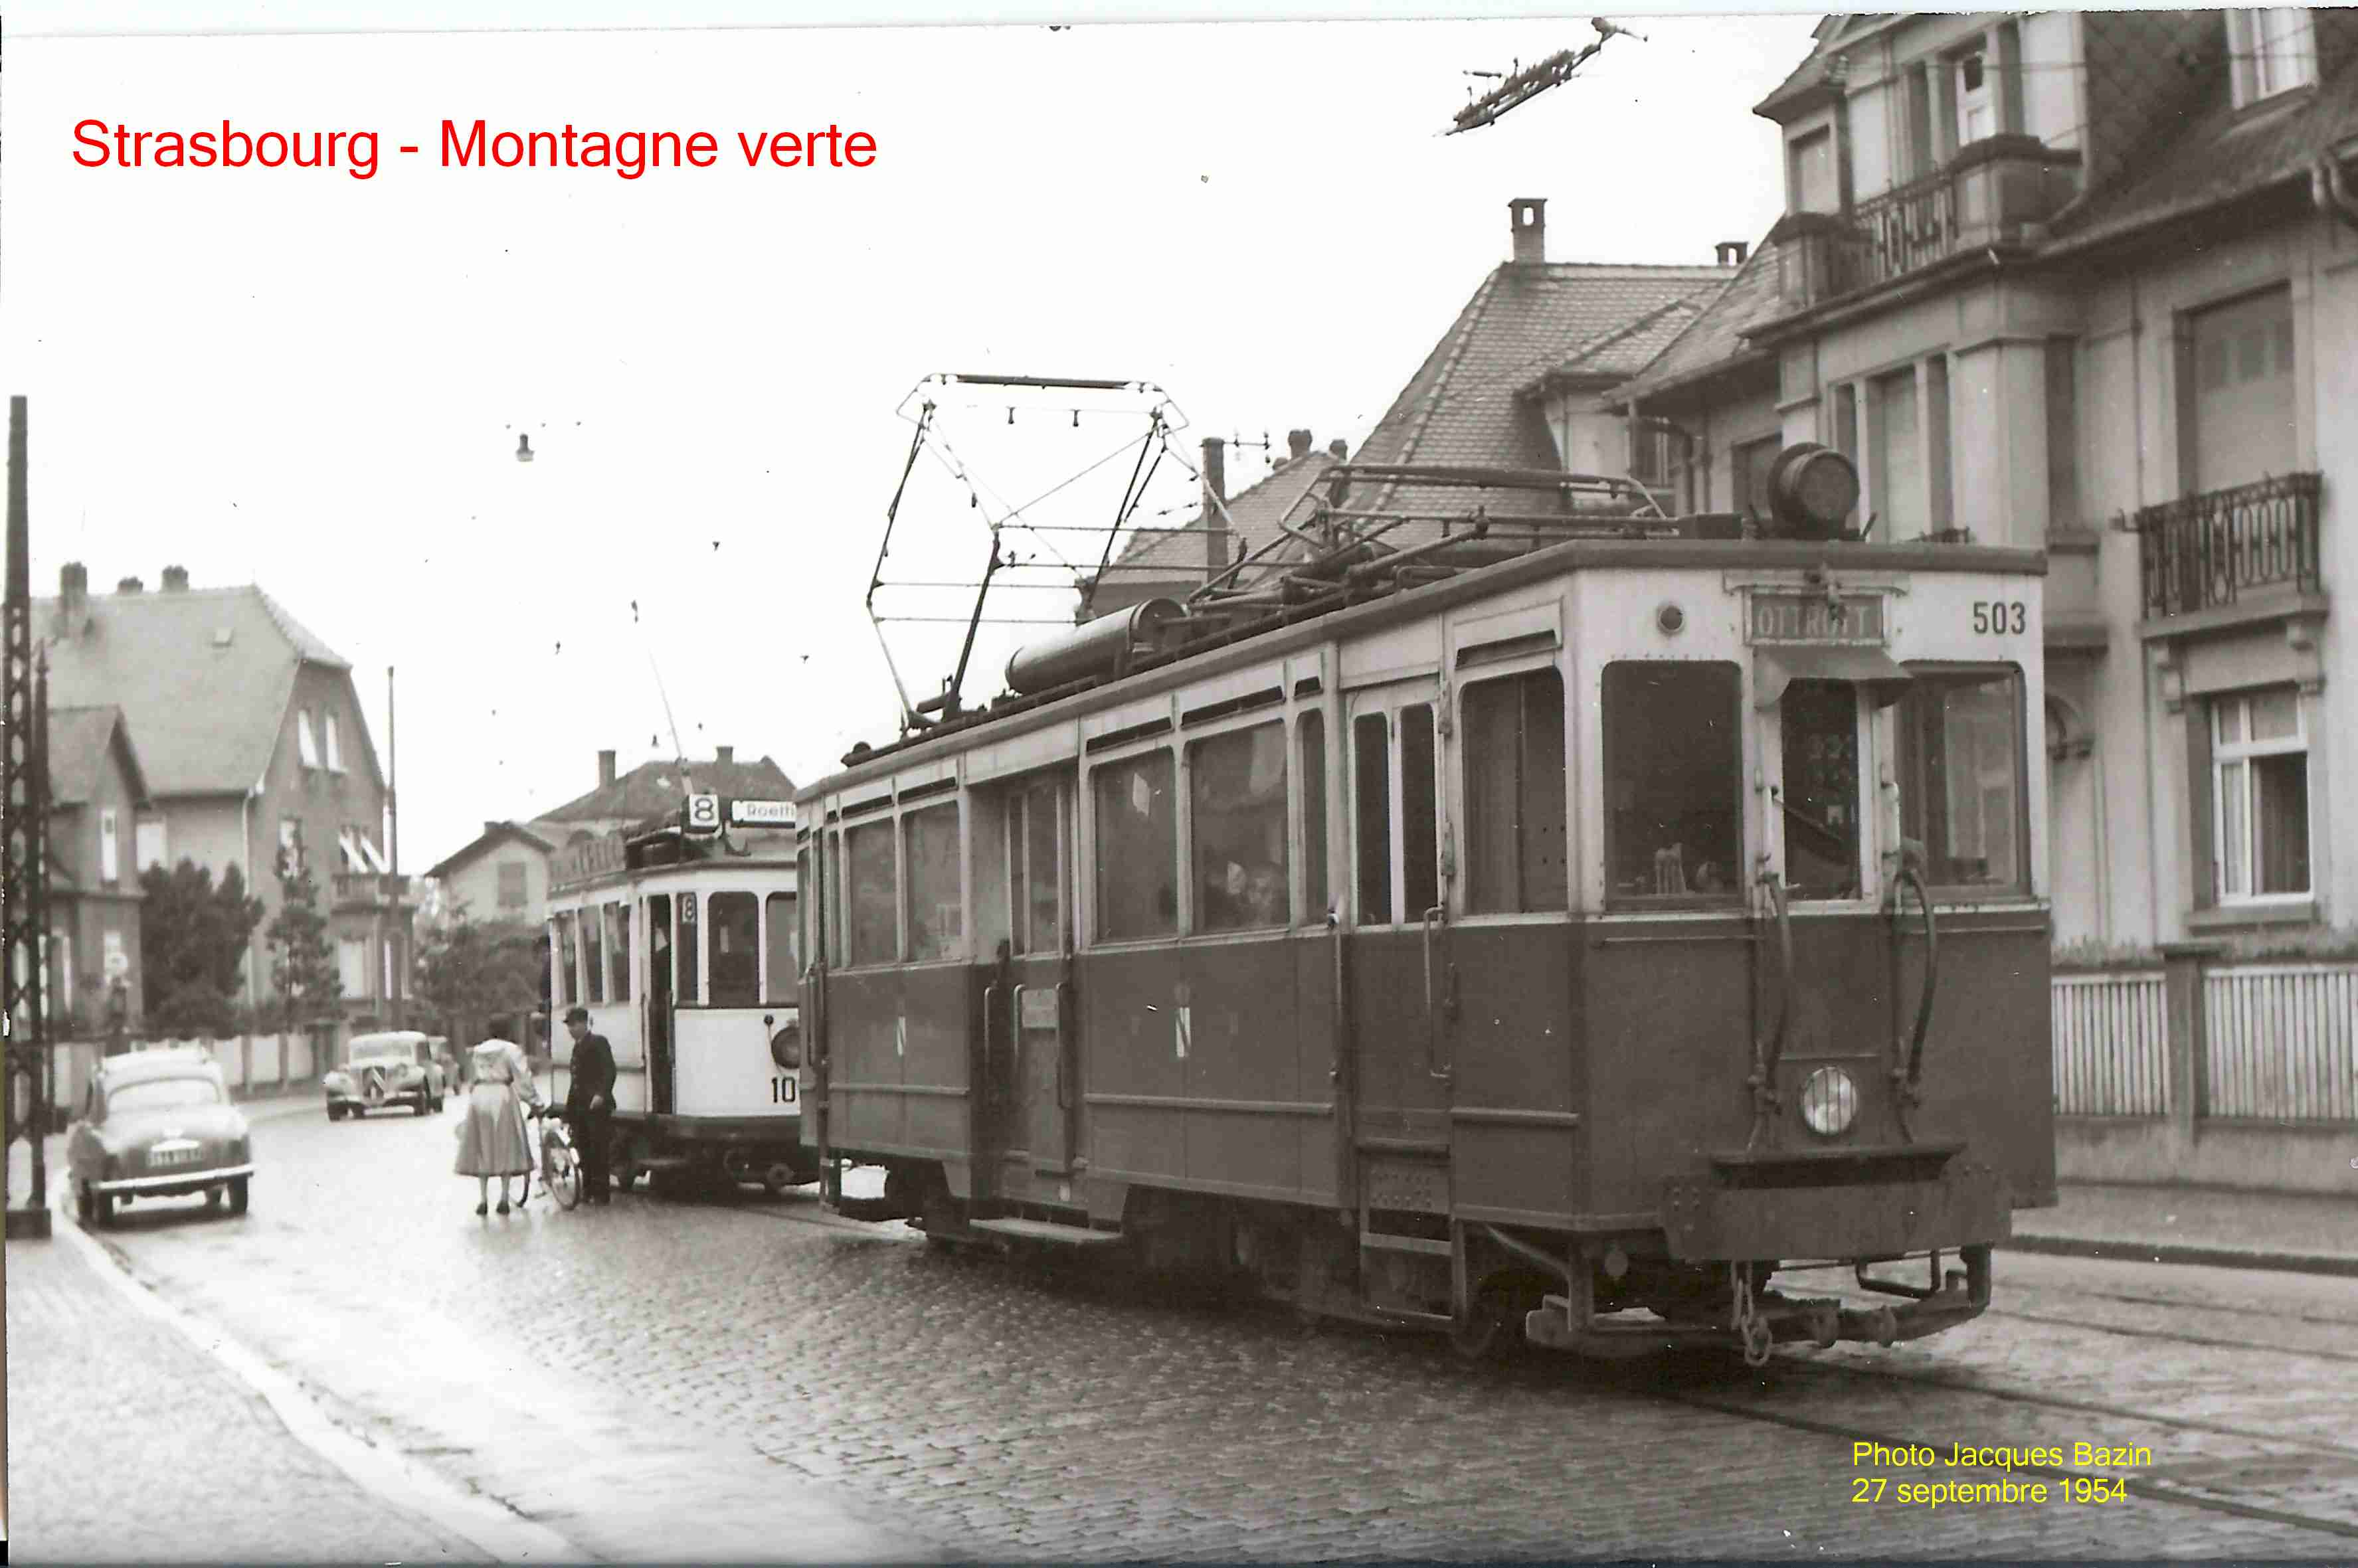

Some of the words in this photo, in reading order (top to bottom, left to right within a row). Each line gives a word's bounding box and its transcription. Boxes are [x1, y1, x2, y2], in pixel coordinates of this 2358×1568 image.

[1758, 605, 1872, 636] OTTROTT
[1973, 601, 2026, 634] 503
[695, 798, 713, 822] 8
[771, 1077, 796, 1103] 10
